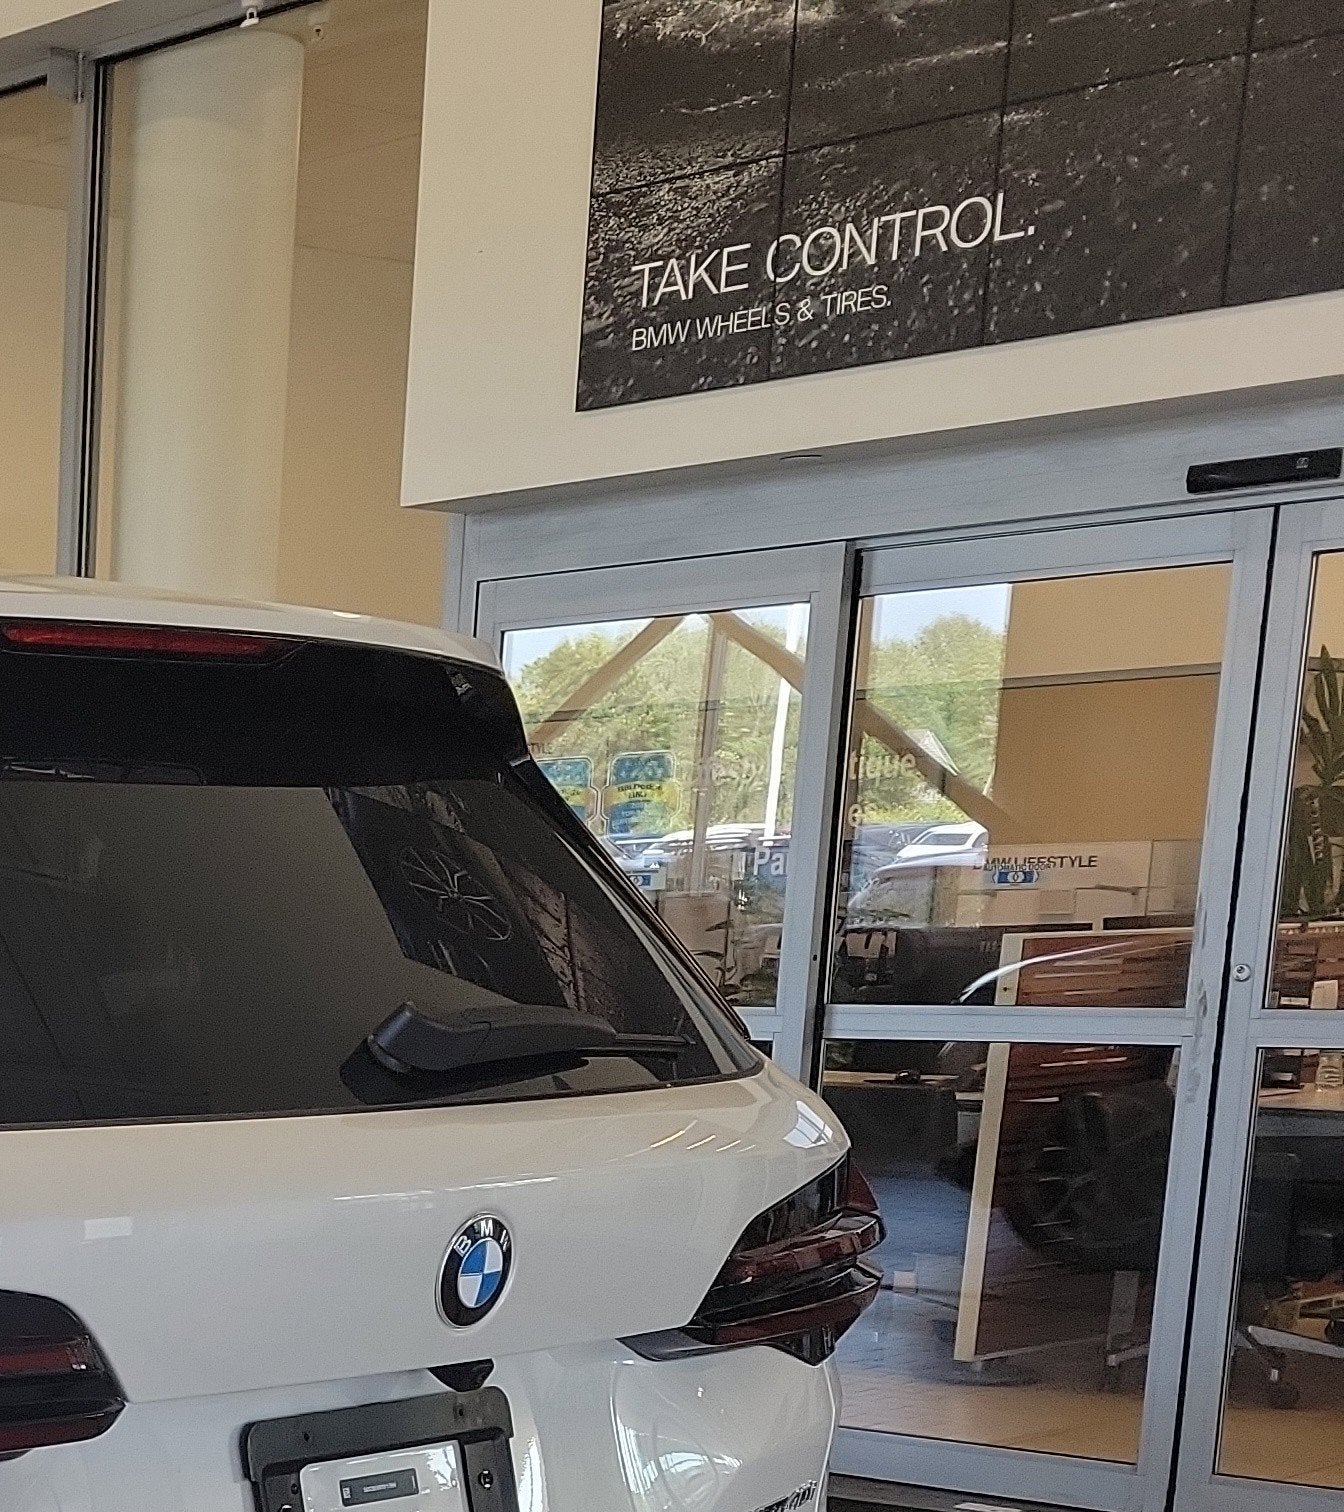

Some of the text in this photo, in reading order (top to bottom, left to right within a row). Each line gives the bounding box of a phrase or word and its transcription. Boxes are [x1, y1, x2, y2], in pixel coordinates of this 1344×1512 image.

[632, 192, 1036, 309] TAKE CONTROL.
[631, 285, 892, 352] BMW WHEELS & TIRES.
[1014, 855, 1098, 870] LIFESTYLE
